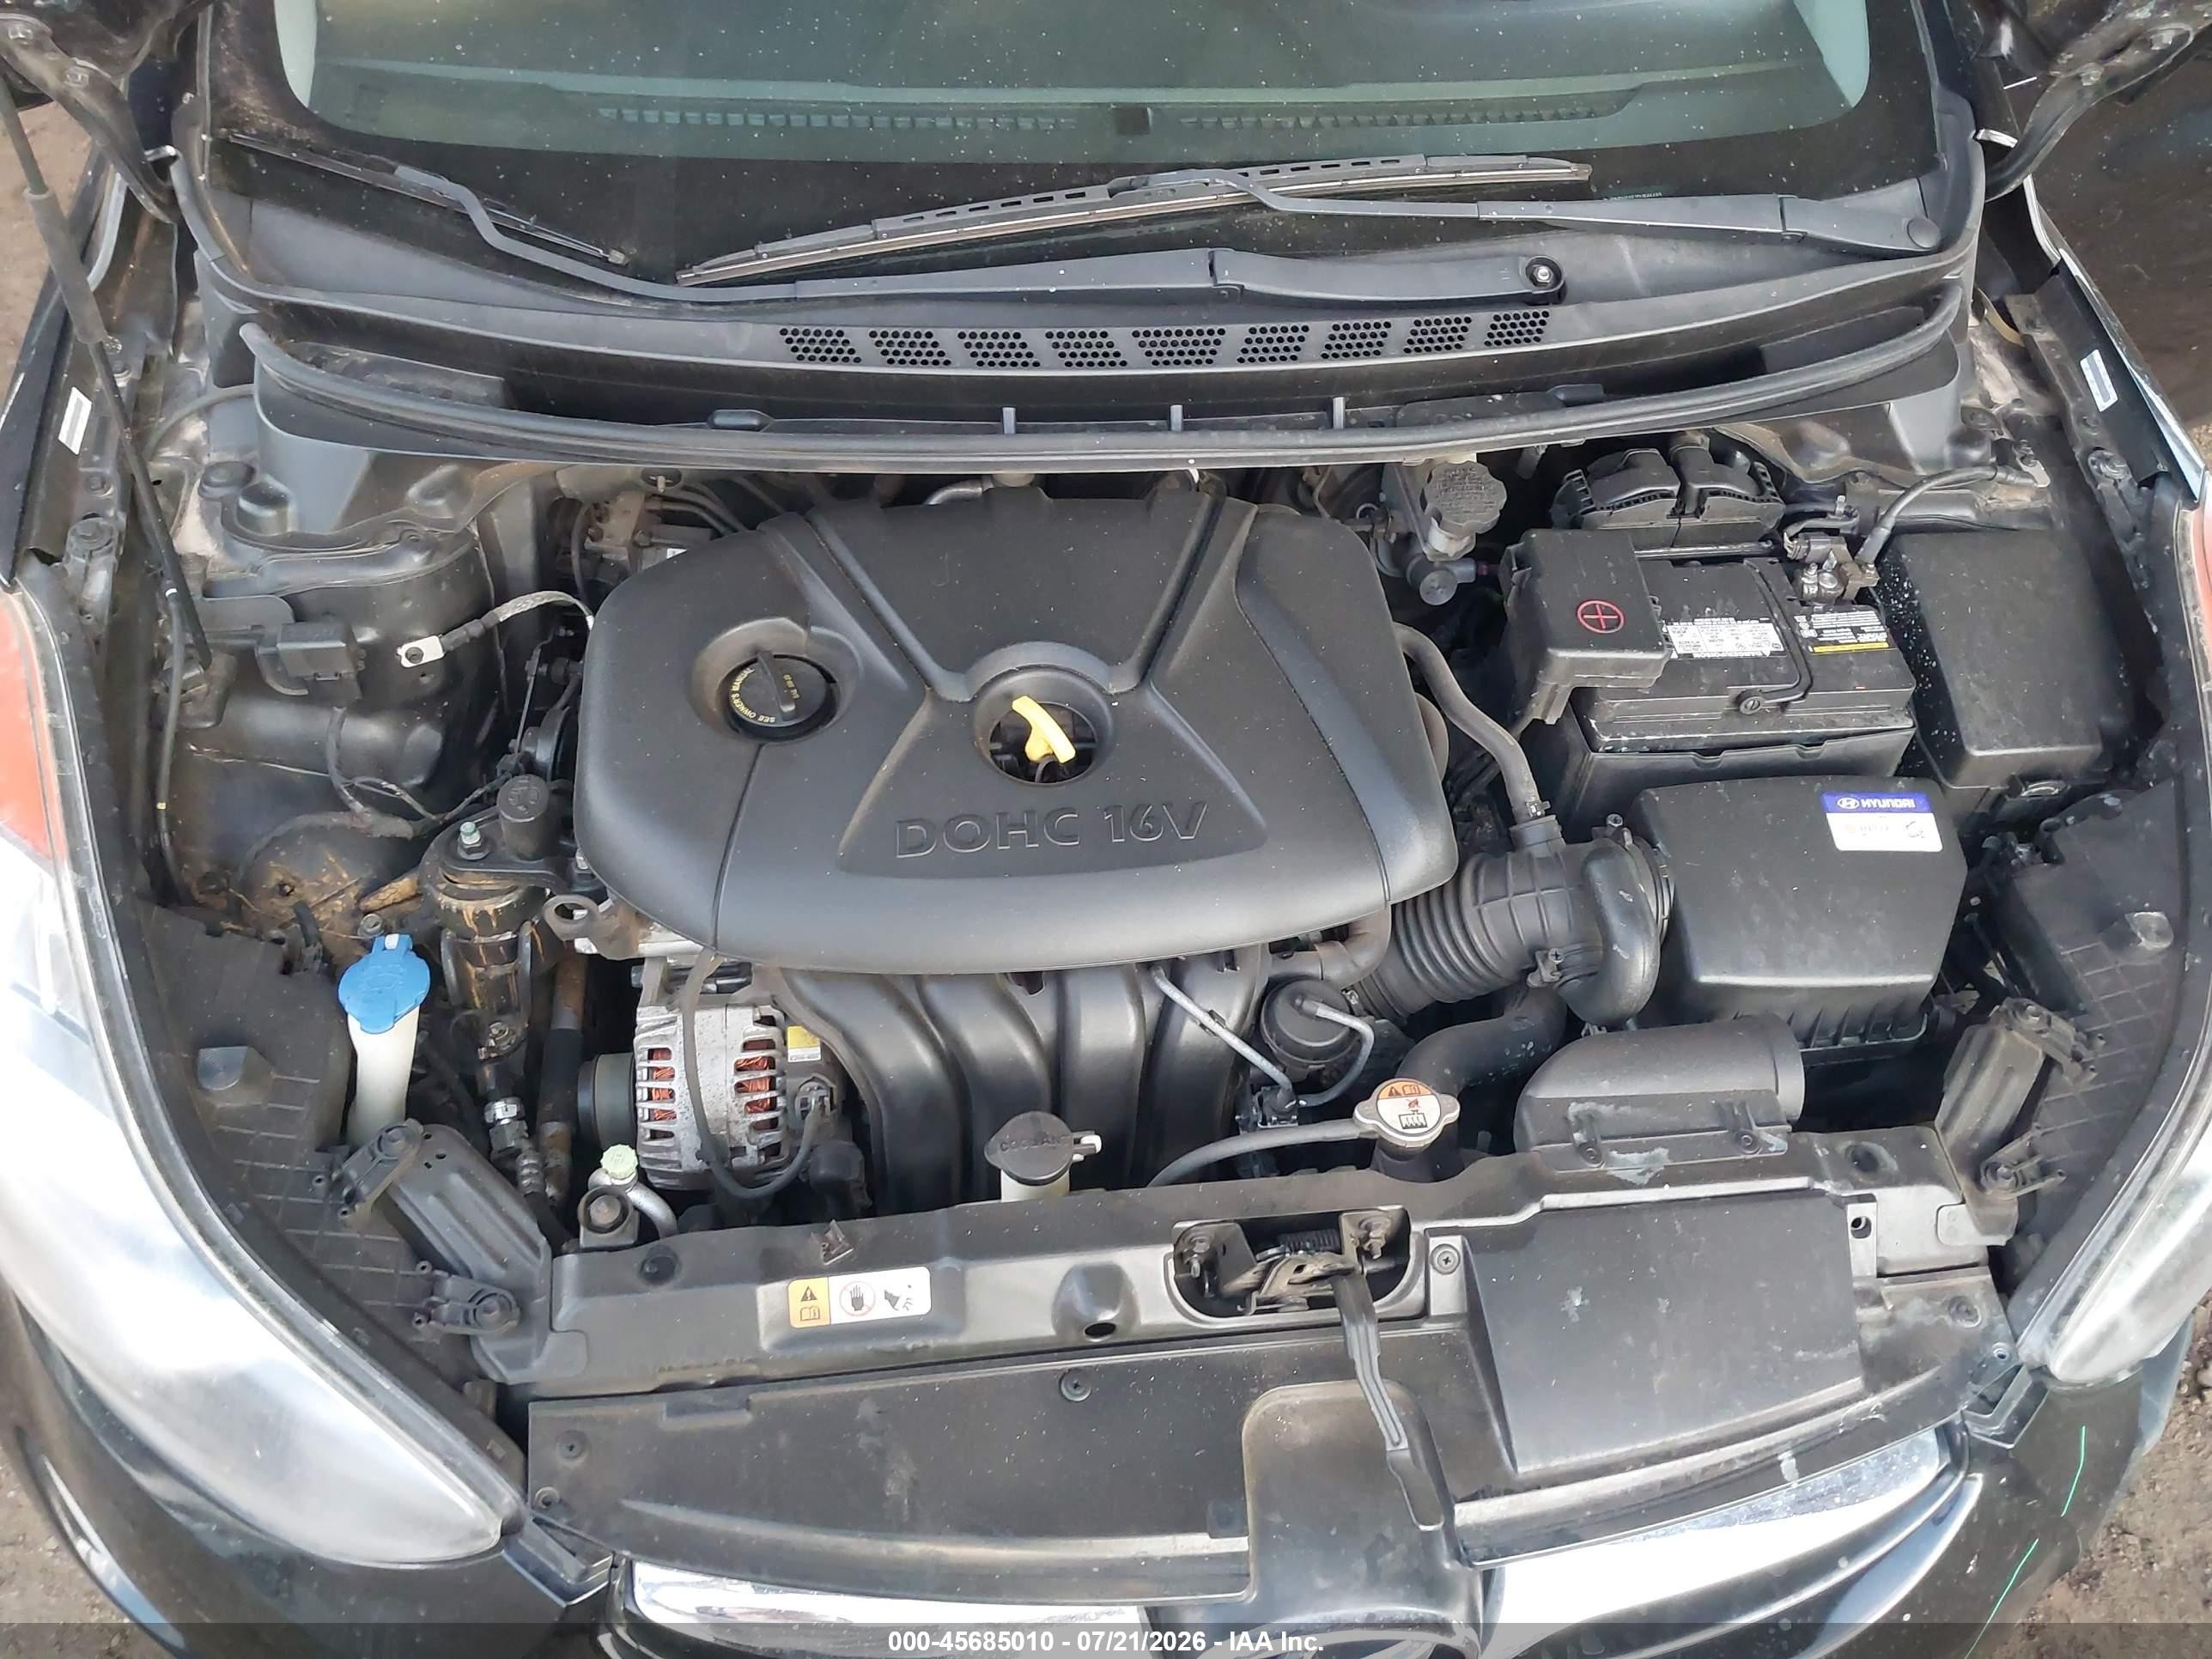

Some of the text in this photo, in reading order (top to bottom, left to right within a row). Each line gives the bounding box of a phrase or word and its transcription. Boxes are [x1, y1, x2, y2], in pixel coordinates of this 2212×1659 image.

[757, 714, 776, 724] SEE
[1860, 798, 1916, 809] HYUNDAI
[896, 800, 1209, 859] DOHC 16V
